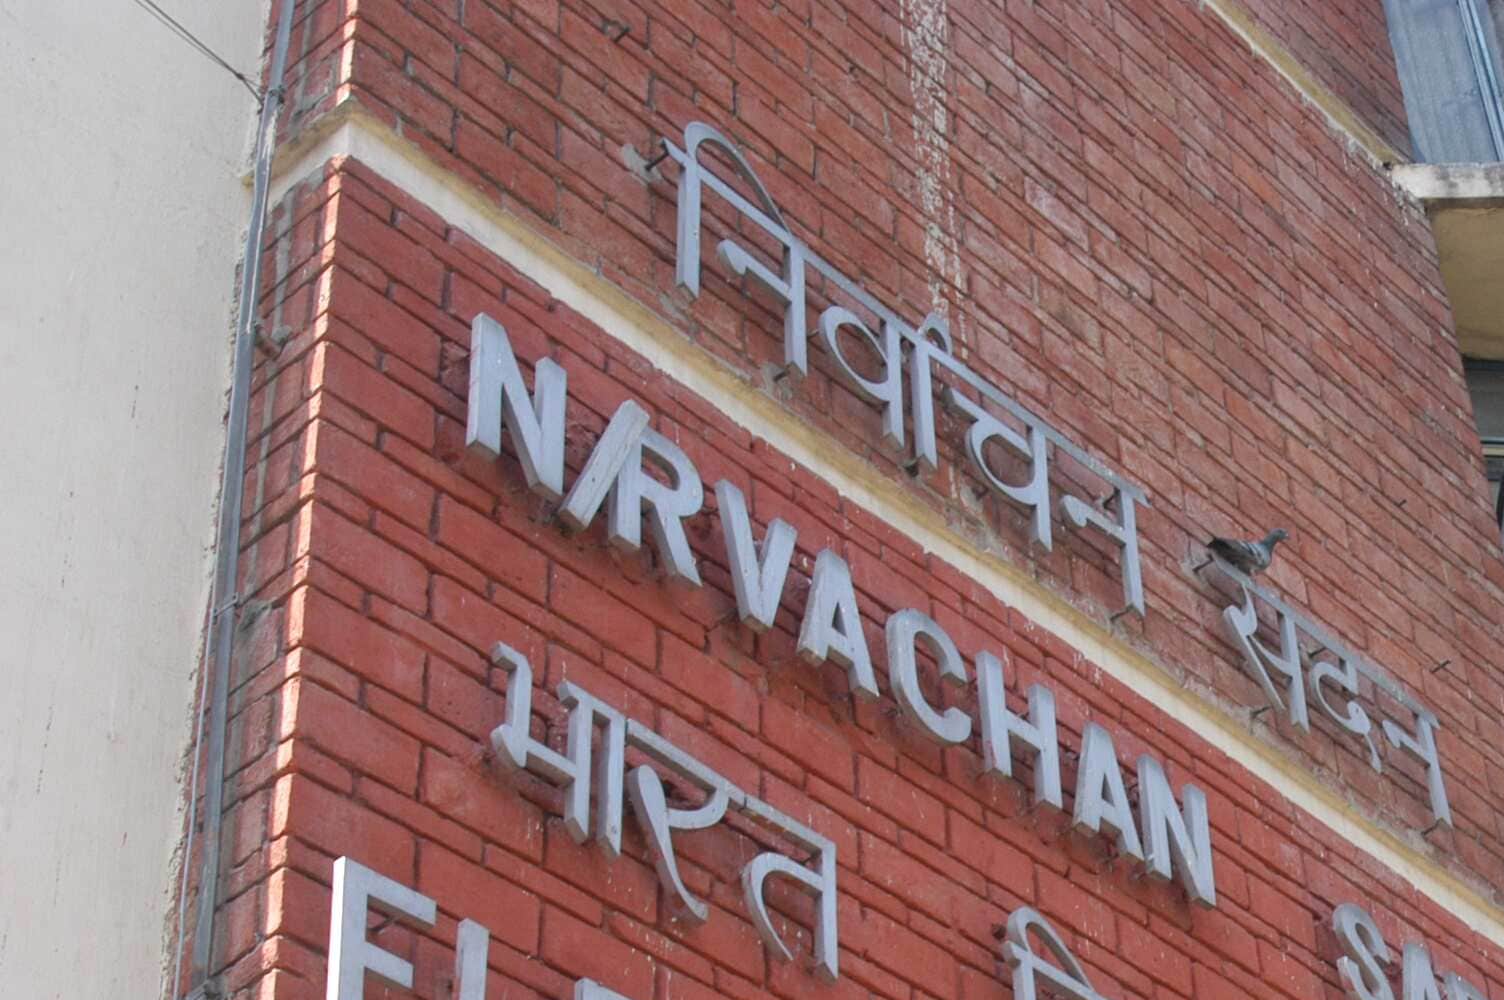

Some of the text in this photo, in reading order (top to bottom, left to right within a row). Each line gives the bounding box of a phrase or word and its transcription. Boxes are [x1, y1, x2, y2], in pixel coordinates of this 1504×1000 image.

[660, 121, 1452, 830] निर्वाचन सदन
[490, 640, 838, 982] भारत
